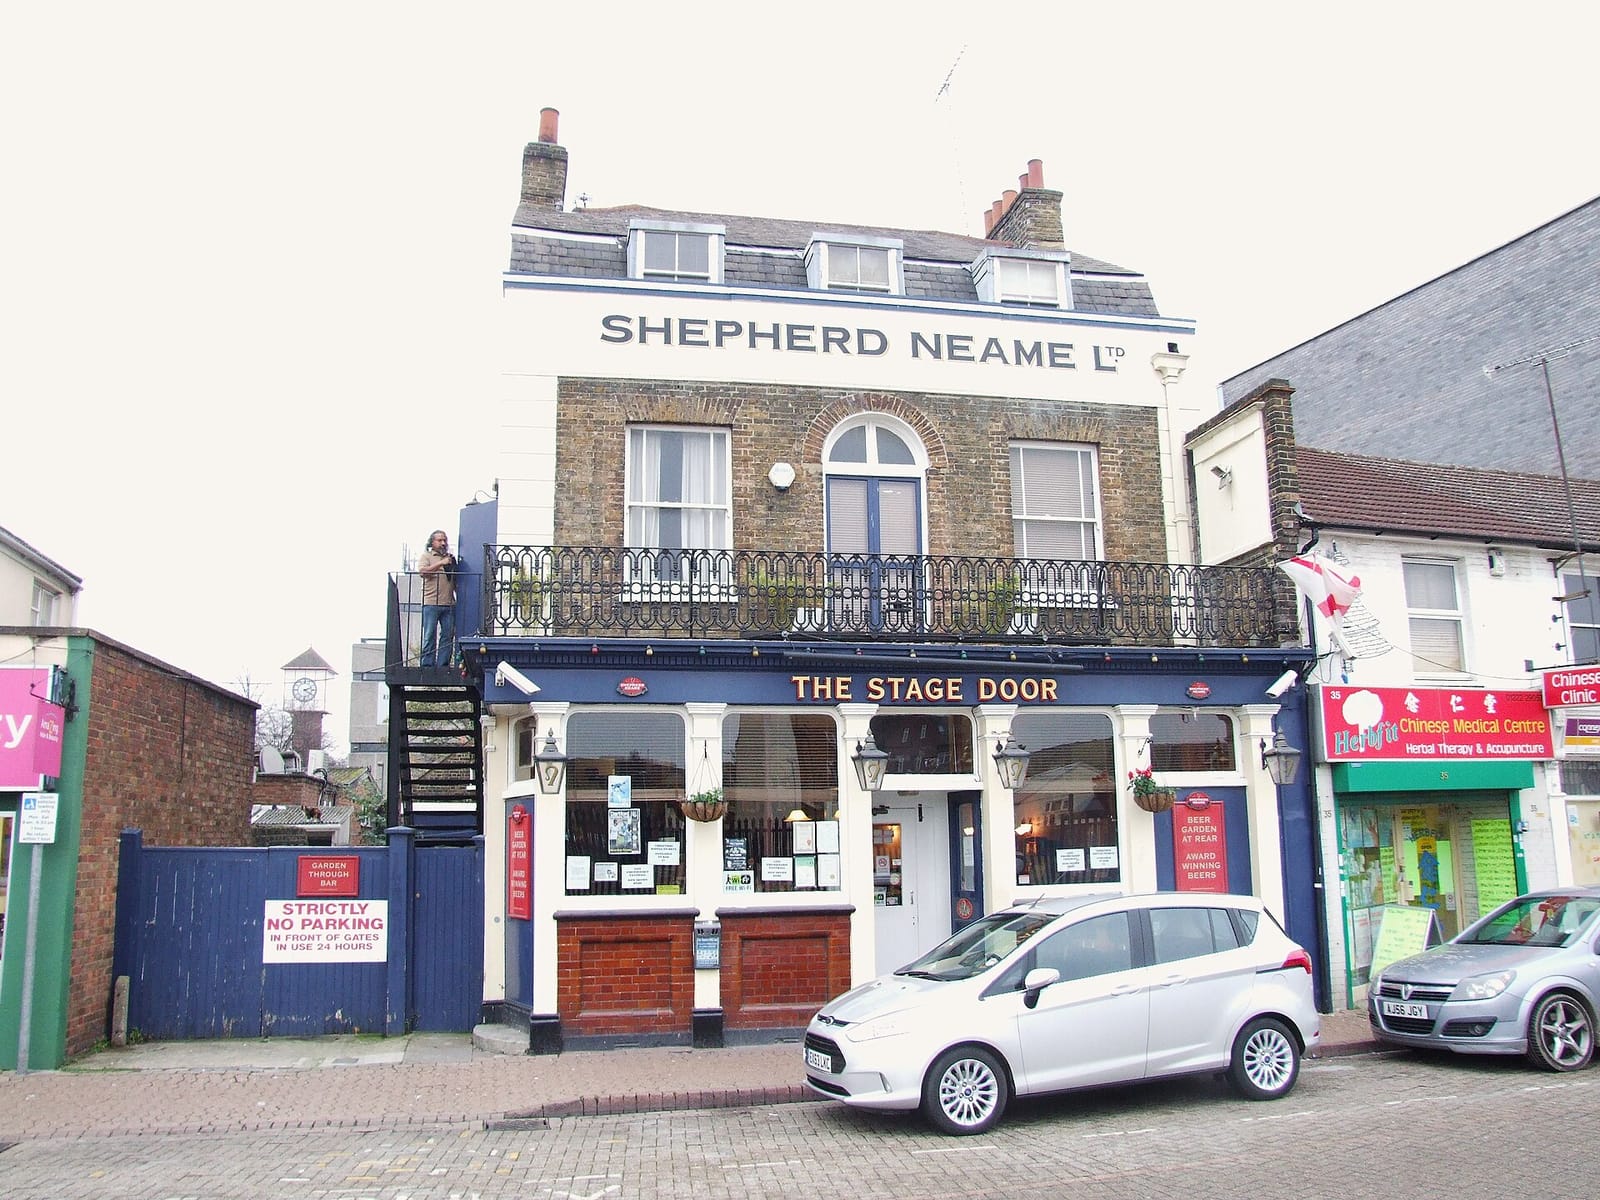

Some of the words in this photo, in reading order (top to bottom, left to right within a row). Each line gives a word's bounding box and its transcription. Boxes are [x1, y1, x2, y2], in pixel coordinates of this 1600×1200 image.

[600, 314, 888, 357] SHEPHERD
[910, 331, 1077, 370] NEAME
[1551, 672, 1600, 688] Chinese
[791, 676, 852, 700] THE
[867, 677, 963, 701] STAGE
[978, 678, 1058, 701] DOOR
[1330, 690, 1341, 700] 35
[1561, 688, 1597, 704] Clinic
[0, 714, 33, 749] y
[1399, 718, 1450, 733] Chinese
[1453, 719, 1500, 733] Medical
[1503, 719, 1545, 733] Centre
[1405, 743, 1435, 754] Herbal
[1437, 743, 1473, 755] Therapy
[1475, 743, 1484, 754] &
[1187, 816, 1211, 824] BEER
[1186, 852, 1216, 860] AWARD
[282, 903, 369, 915] STRICTLY
[267, 918, 294, 930] NO
[301, 918, 384, 930] PARKING
[270, 934, 281, 942] IN
[285, 934, 322, 942] FRONT
[344, 933, 379, 941] GATES
[1407, 1004, 1423, 1016] JGY
